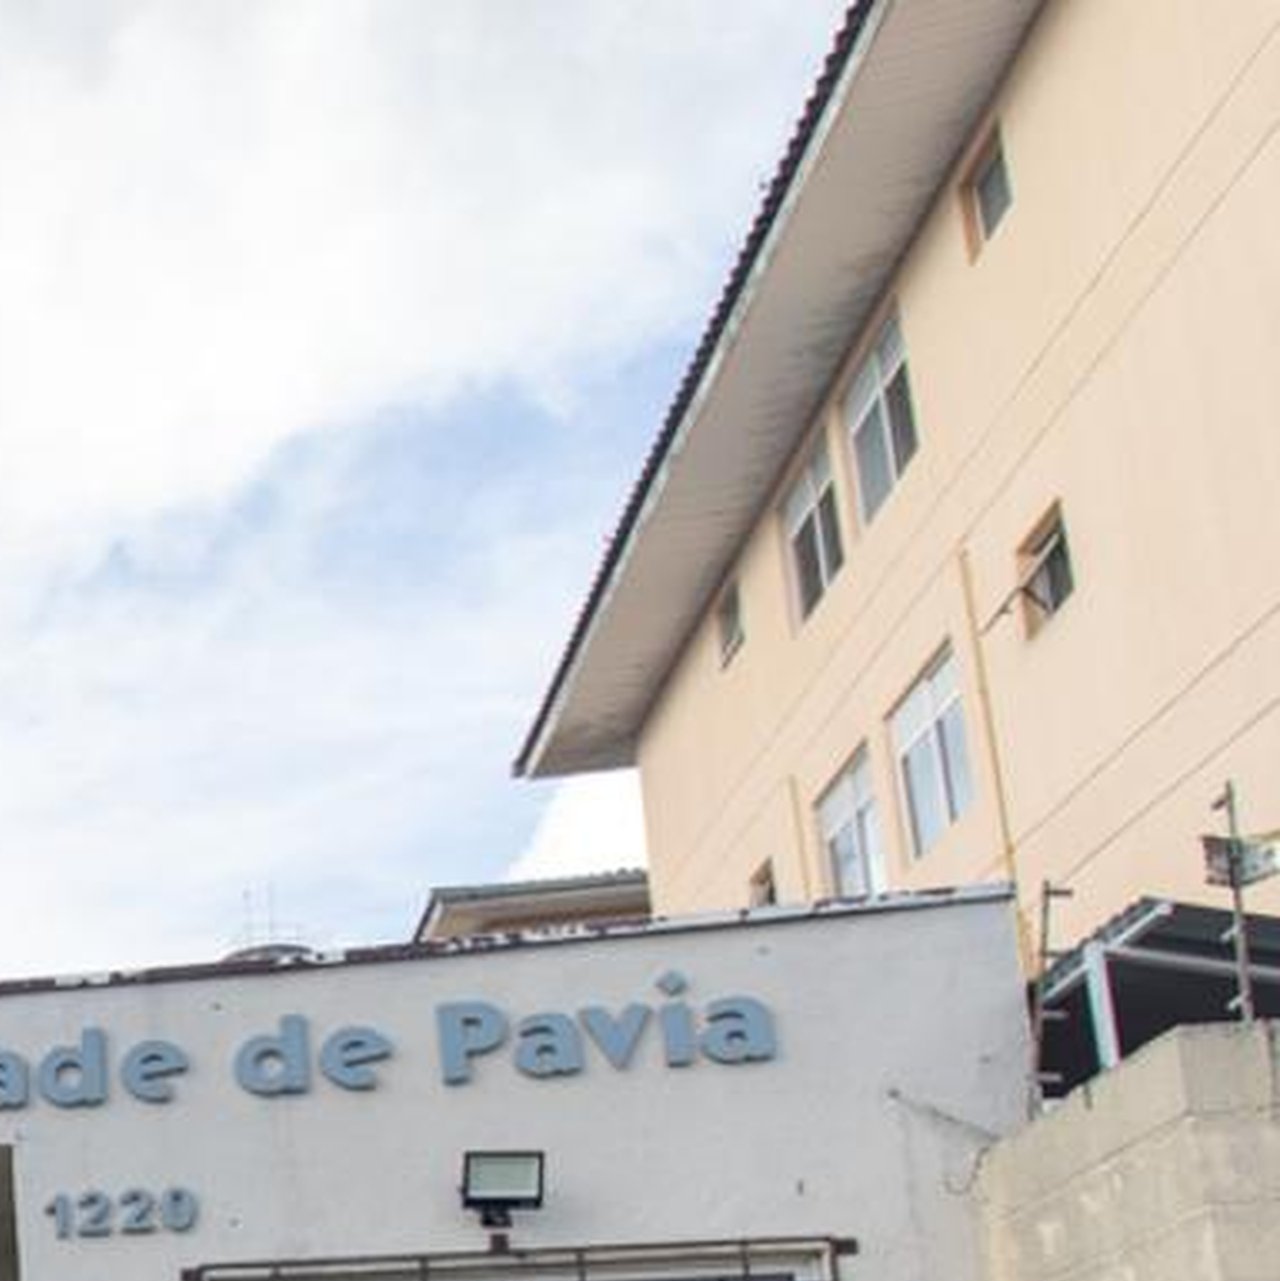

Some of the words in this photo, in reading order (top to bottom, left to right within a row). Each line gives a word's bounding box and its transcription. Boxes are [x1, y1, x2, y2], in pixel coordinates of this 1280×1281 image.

[234, 1013, 395, 1098] de
[434, 970, 778, 1086] Pavia
[45, 1187, 201, 1239] 1220
